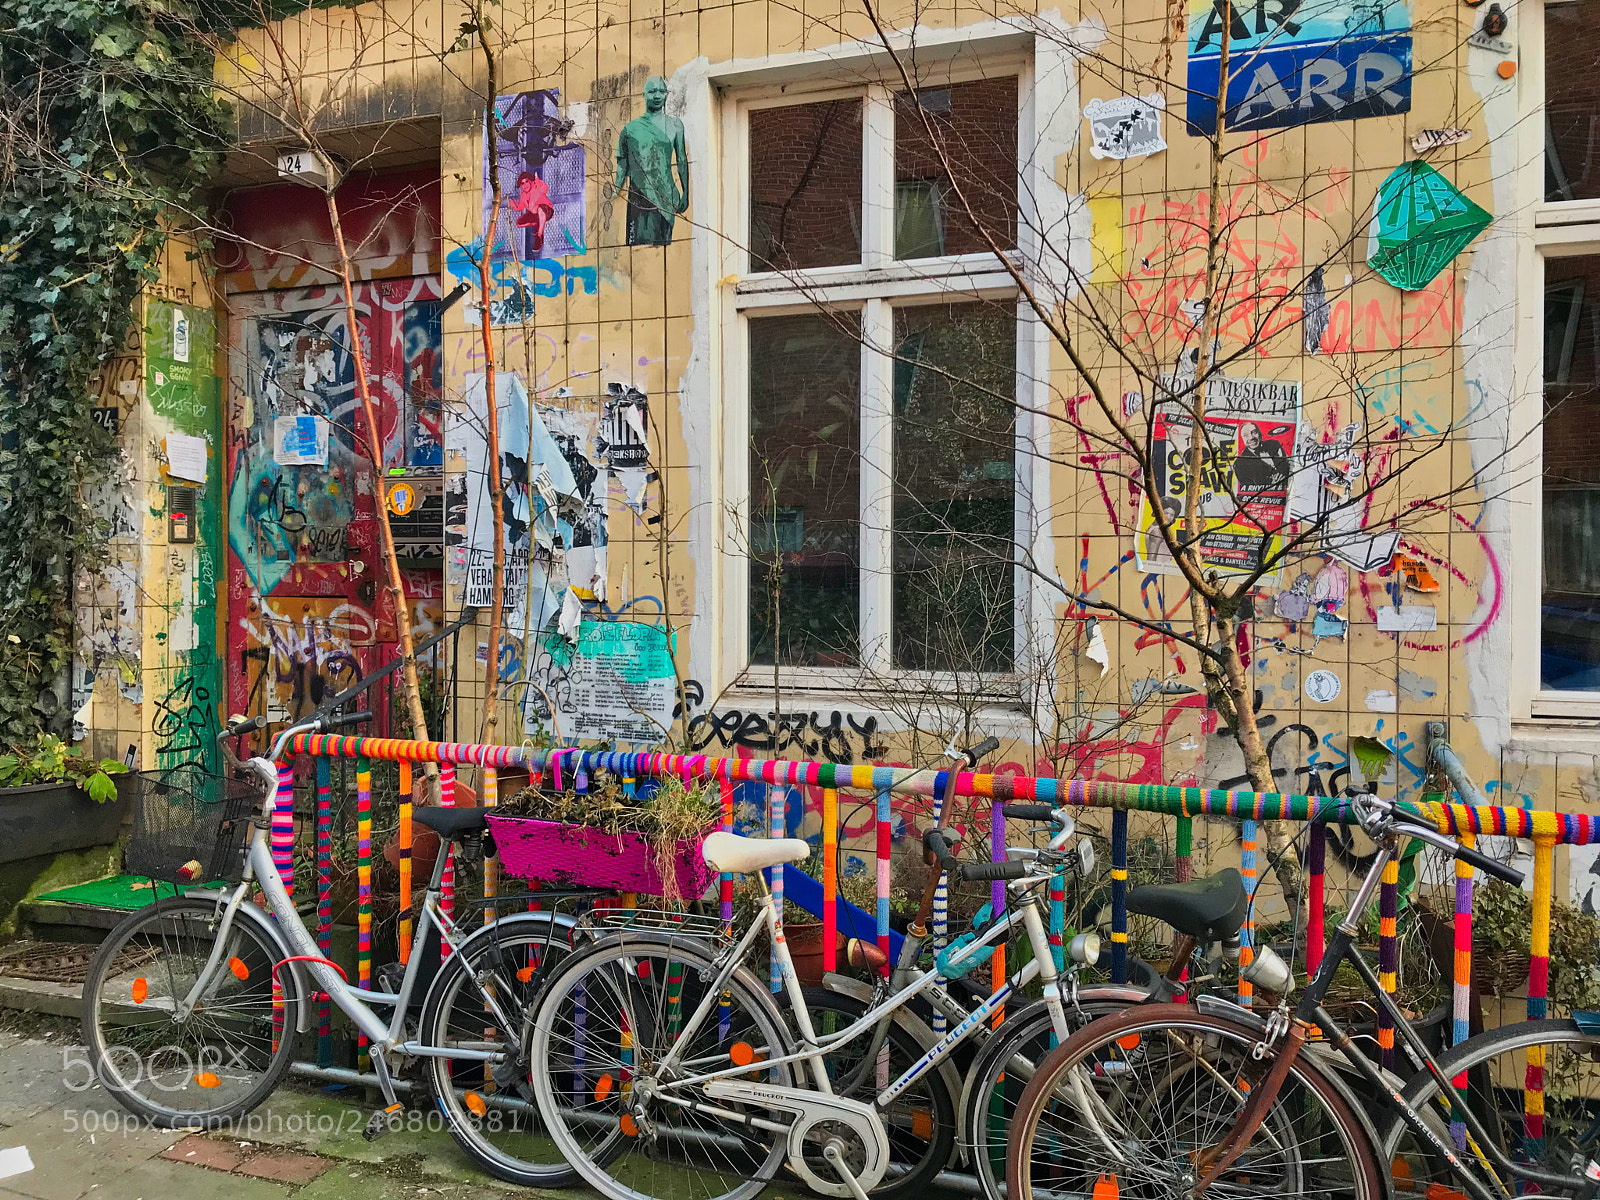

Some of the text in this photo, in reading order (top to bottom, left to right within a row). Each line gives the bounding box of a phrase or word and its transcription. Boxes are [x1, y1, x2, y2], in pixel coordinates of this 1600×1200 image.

[1234, 52, 1404, 123] ARR
[287, 155, 301, 172] 24
[1162, 377, 1298, 401] KOMT MUSIKBAR
[1168, 440, 1236, 470] COE
[1169, 466, 1235, 495] SAW
[1260, 497, 1282, 505] REVUE
[471, 549, 485, 567] 22.
[469, 587, 514, 605] HAMRG
[927, 1004, 988, 1061] PEUGEOT
[753, 1091, 785, 1101] PEUGEOT
[1407, 1108, 1443, 1148] GAZELLE
